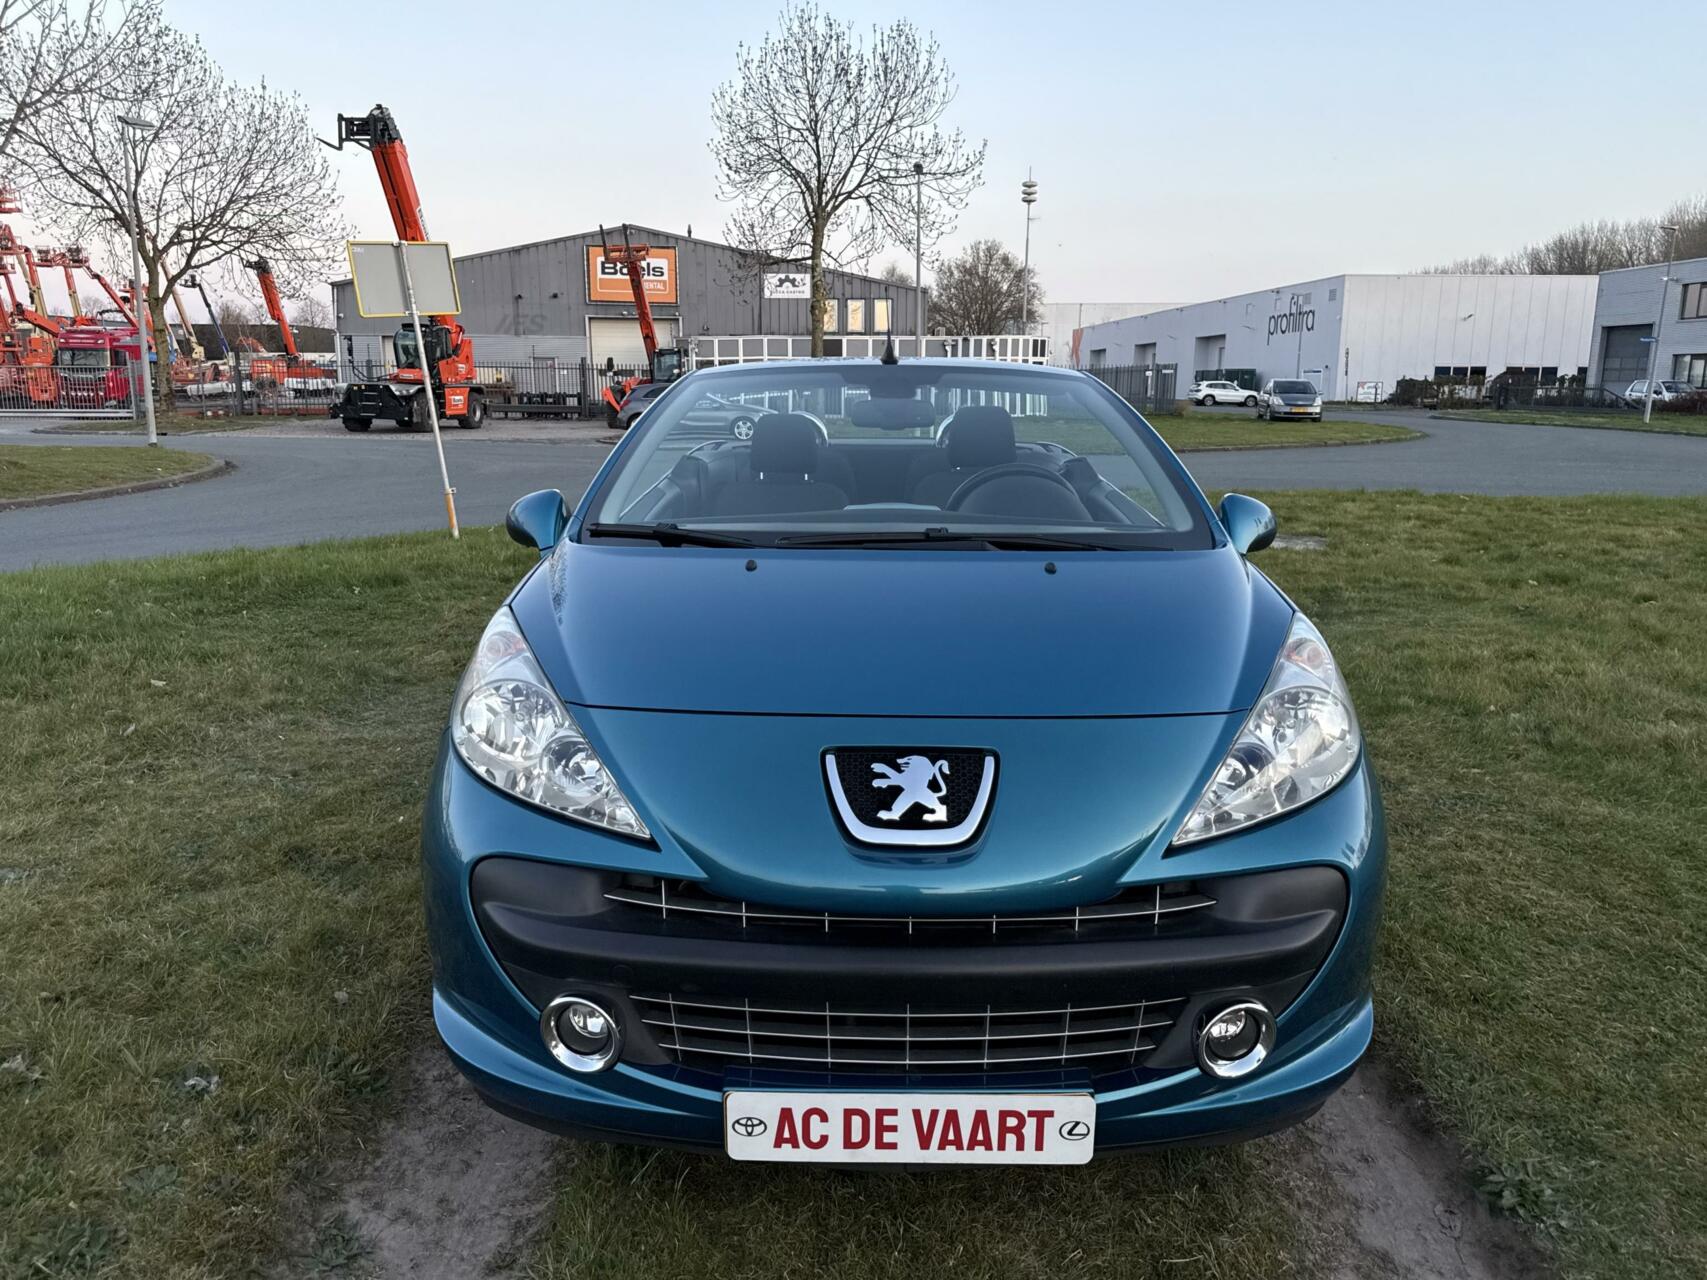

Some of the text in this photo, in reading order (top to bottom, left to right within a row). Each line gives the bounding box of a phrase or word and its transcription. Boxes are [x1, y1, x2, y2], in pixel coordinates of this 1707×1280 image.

[1266, 294, 1316, 346] profiltra
[773, 1106, 1055, 1152] AC DE VAART
